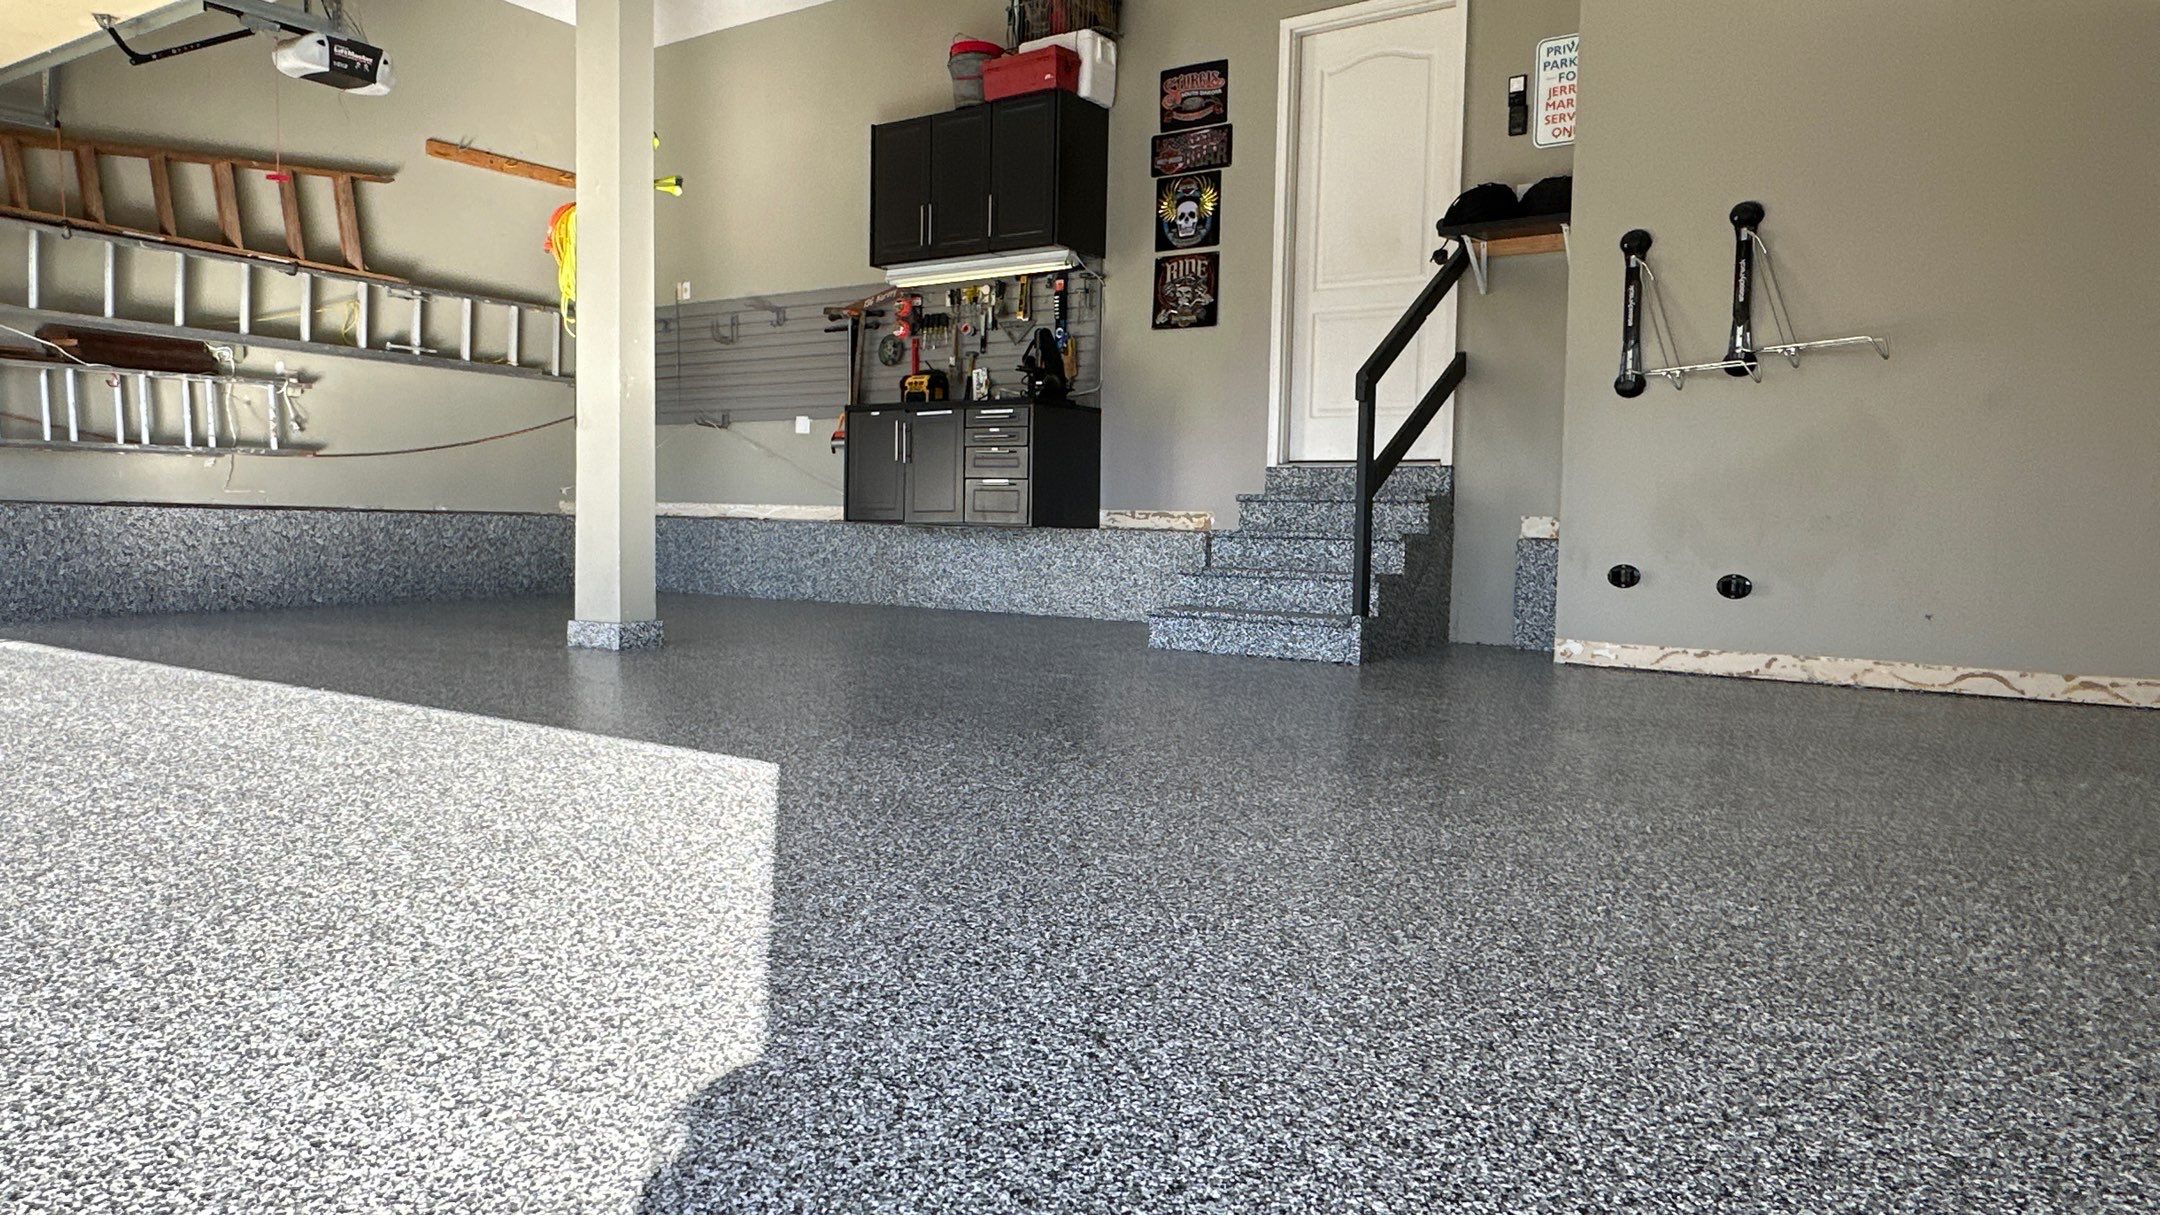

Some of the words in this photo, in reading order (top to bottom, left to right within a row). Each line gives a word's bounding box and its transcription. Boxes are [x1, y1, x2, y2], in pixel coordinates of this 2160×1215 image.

[1547, 84, 1577, 100] JERR
[1545, 98, 1574, 111] MAR
[1544, 111, 1576, 125] SERV
[1165, 258, 1208, 283] RIDE
